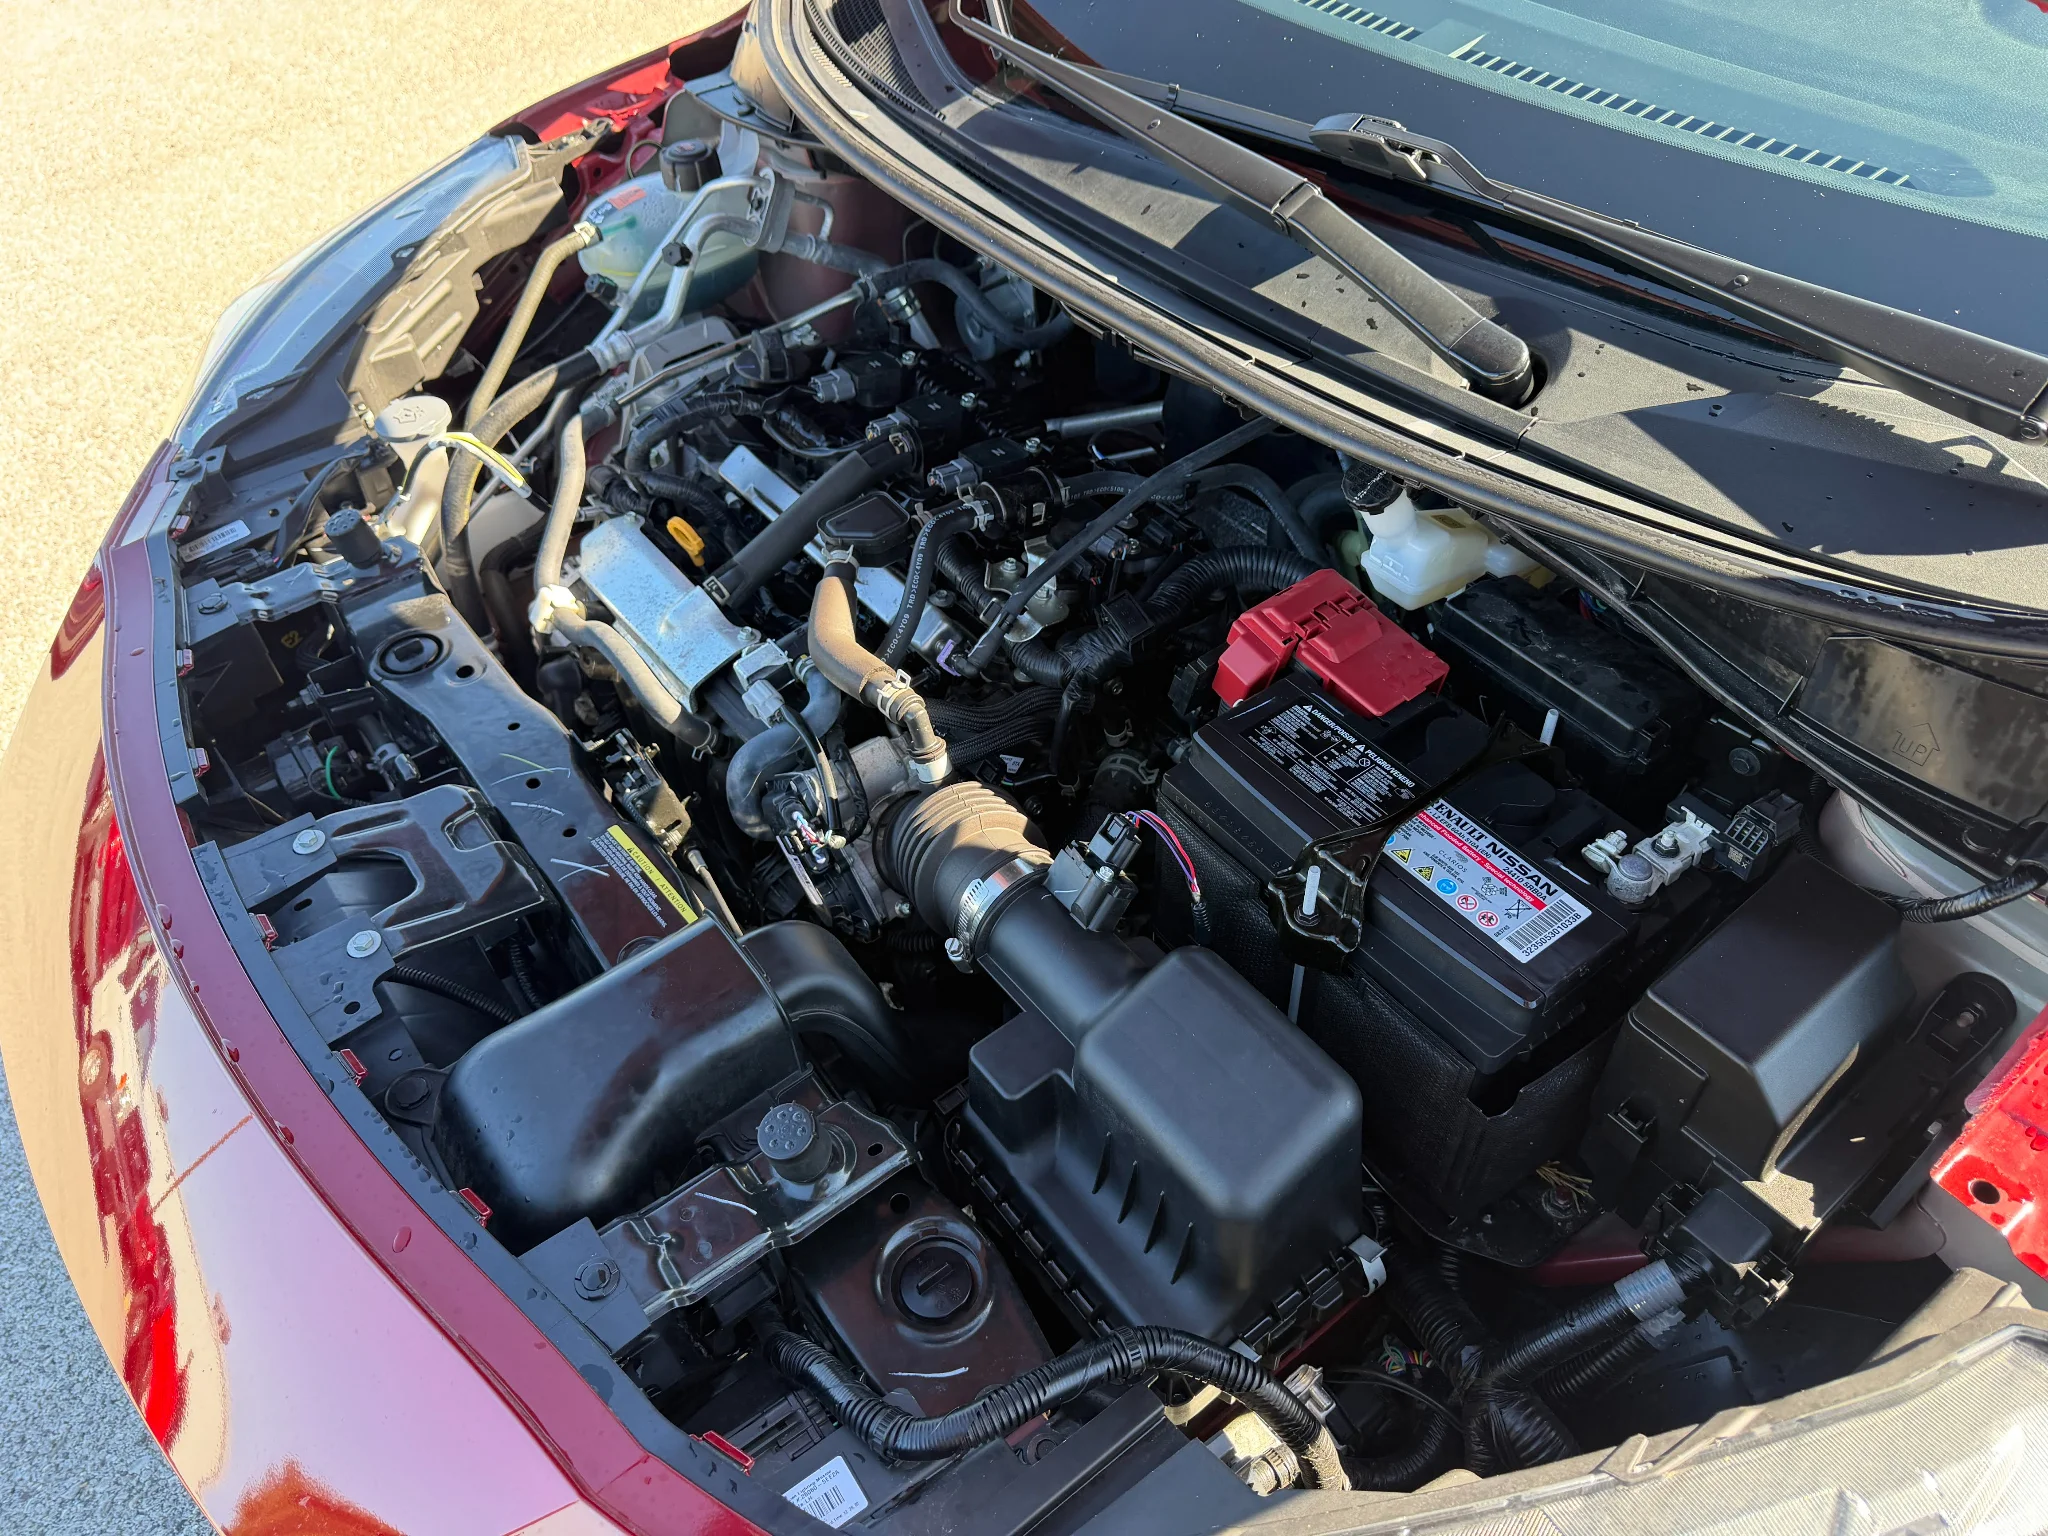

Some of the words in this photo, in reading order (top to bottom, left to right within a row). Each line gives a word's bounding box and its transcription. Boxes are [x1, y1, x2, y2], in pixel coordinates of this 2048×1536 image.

[1311, 708, 1357, 744] DANGER/POISON
[1900, 740, 1928, 757] UP
[1364, 749, 1416, 788] PELIGRO/VENENO
[1418, 811, 1442, 831] nhanced
[1440, 828, 1463, 847] Flooded
[1460, 844, 1482, 862] Battery
[1483, 861, 1505, 879] Special
[1502, 876, 1535, 902] technology
[1438, 849, 1468, 873] CLARIOS
[1485, 841, 1558, 897] NISSAN
[1502, 865, 1524, 883] 24410
[632, 850, 655, 874] CAUTION
[660, 883, 687, 913] ATTENTION
[1522, 912, 1582, 957] 323505301033B
